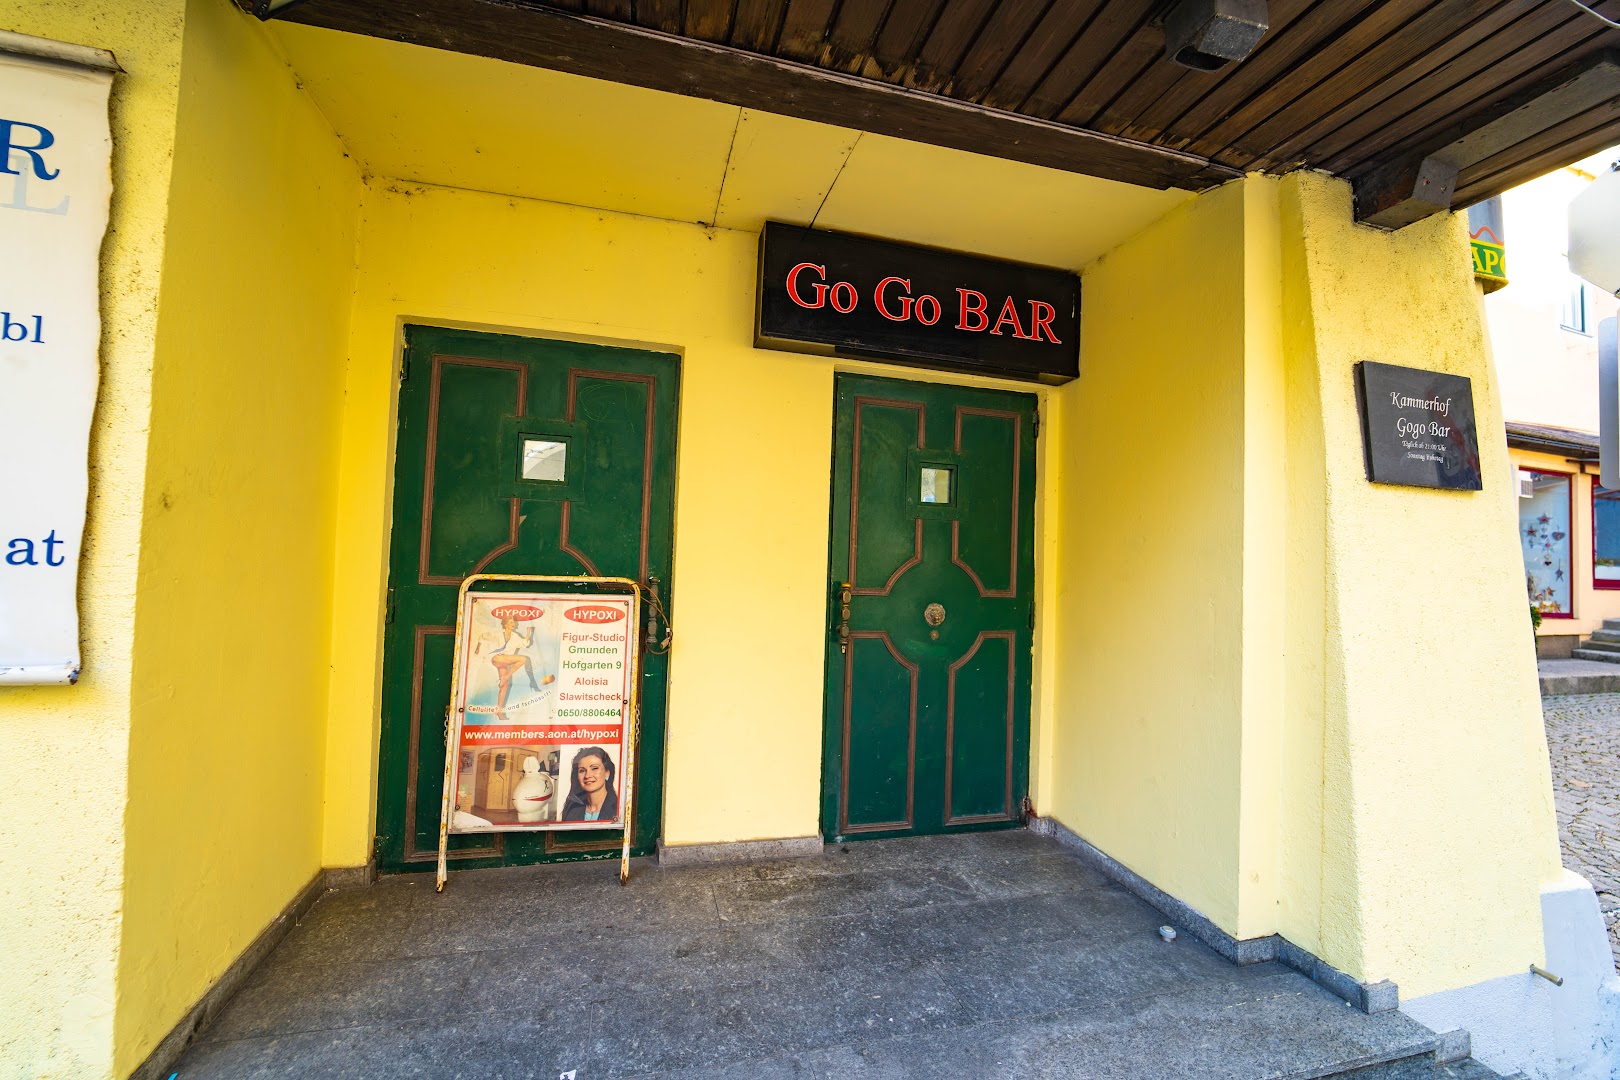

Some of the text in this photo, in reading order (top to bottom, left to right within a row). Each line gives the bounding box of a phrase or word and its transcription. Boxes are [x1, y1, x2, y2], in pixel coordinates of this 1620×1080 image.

[785, 262, 1062, 345] Go Go BAR
[0, 311, 45, 344] bl
[1390, 391, 1451, 417] Kammerhof
[1397, 417, 1451, 440] Gogo Bar
[5, 529, 65, 567] at
[495, 608, 540, 618] HYPOXI
[573, 610, 617, 620] HYPOXI
[562, 632, 625, 644] Figur-Studio
[568, 645, 618, 655] Gmunden
[562, 660, 622, 671] Hofgarten 9
[574, 677, 609, 686] Aloisia
[559, 692, 622, 701] Slawitscheck
[557, 708, 622, 718] 0650/8806464
[465, 728, 619, 741] www.members.aon.at/hypoxi
